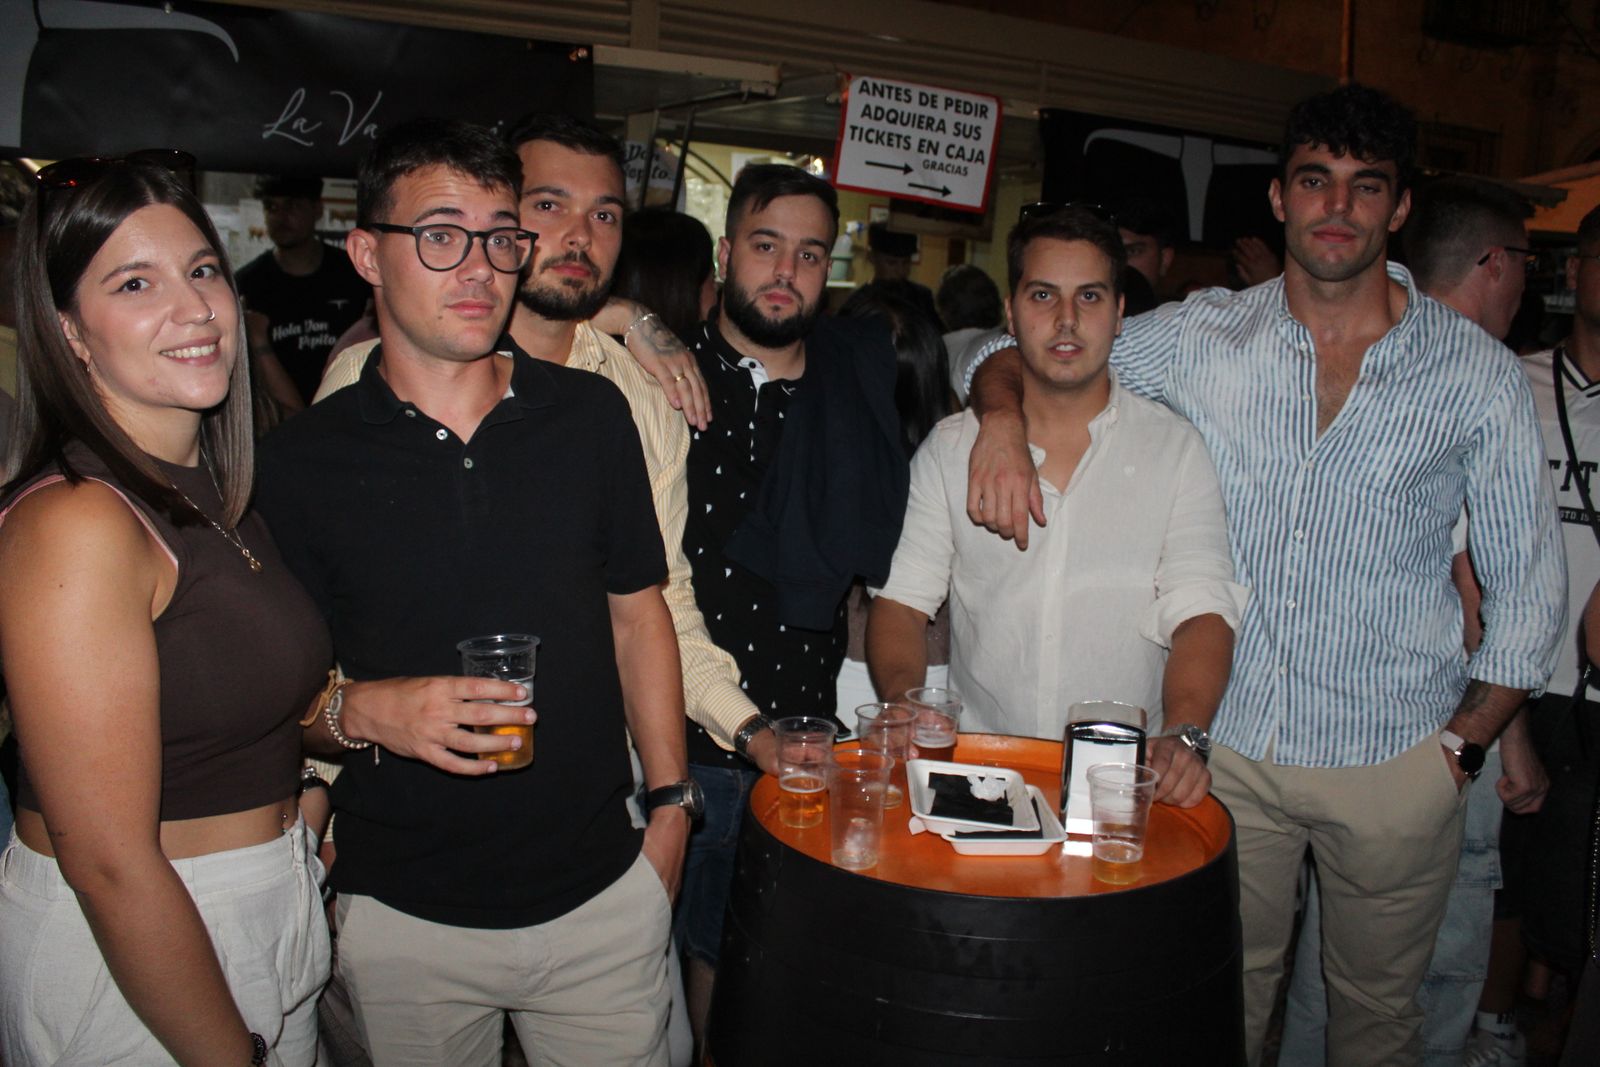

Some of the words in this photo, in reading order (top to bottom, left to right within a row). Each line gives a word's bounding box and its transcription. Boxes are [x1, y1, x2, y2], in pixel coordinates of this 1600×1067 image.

[262, 87, 322, 147] La
[858, 79, 912, 104] ANTES
[918, 91, 938, 109] DE
[944, 97, 989, 120] PEDIR
[860, 103, 947, 135] ADQUIERA
[952, 121, 982, 141] SUS
[849, 125, 911, 151] TICKETS
[917, 139, 940, 156] EN
[945, 144, 985, 165] CAJA
[922, 159, 968, 177] GRACIAS
[272, 322, 302, 342] Hola
